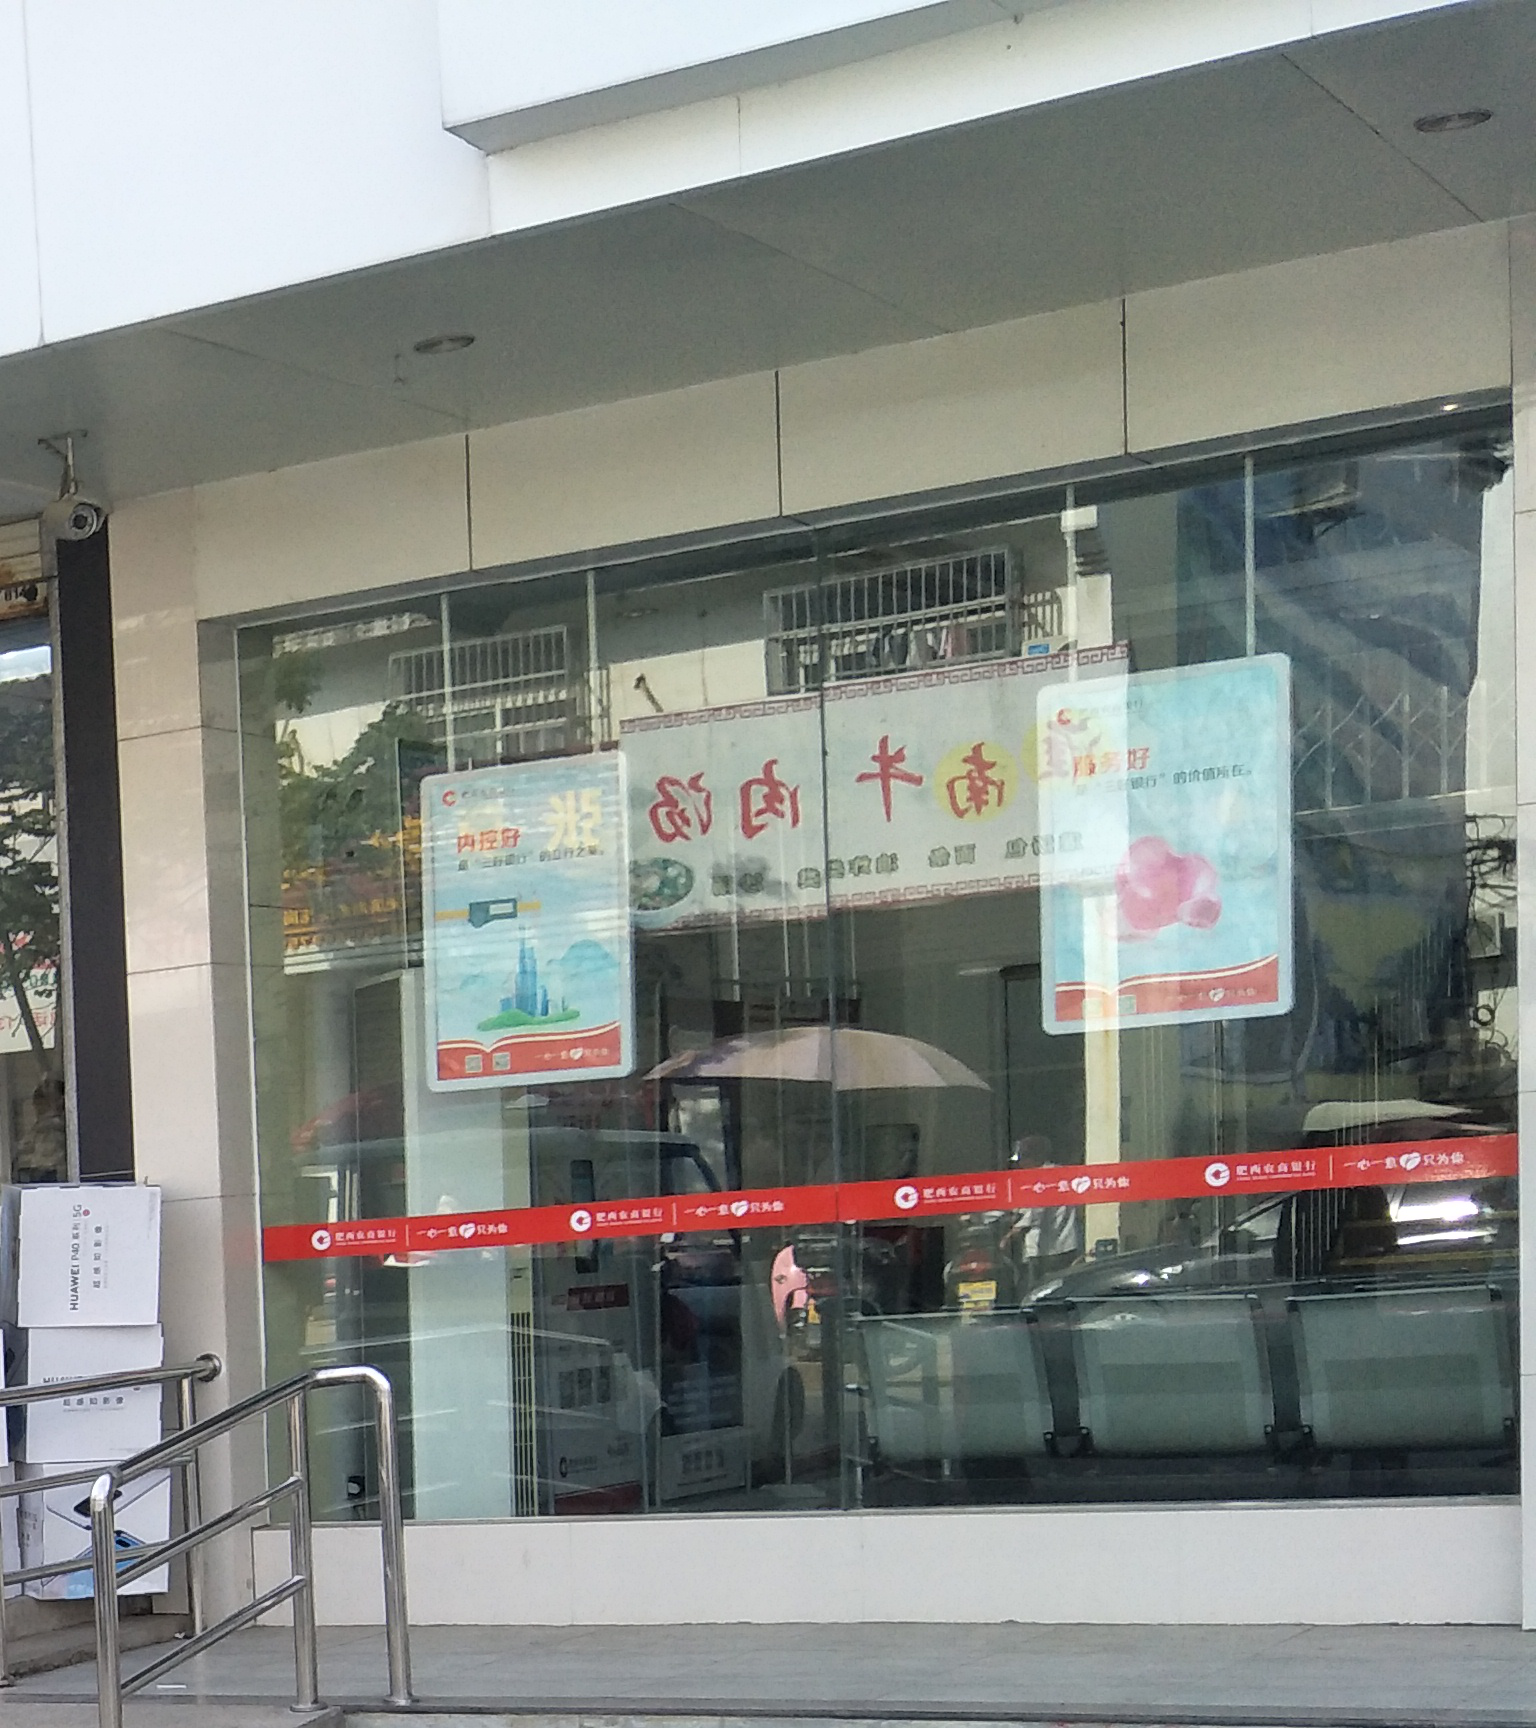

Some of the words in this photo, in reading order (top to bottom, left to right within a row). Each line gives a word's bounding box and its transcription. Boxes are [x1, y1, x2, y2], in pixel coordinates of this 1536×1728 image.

[1236, 1160, 1316, 1177] 肥西农商银行
[69, 1265, 80, 1311] HUAWEI
